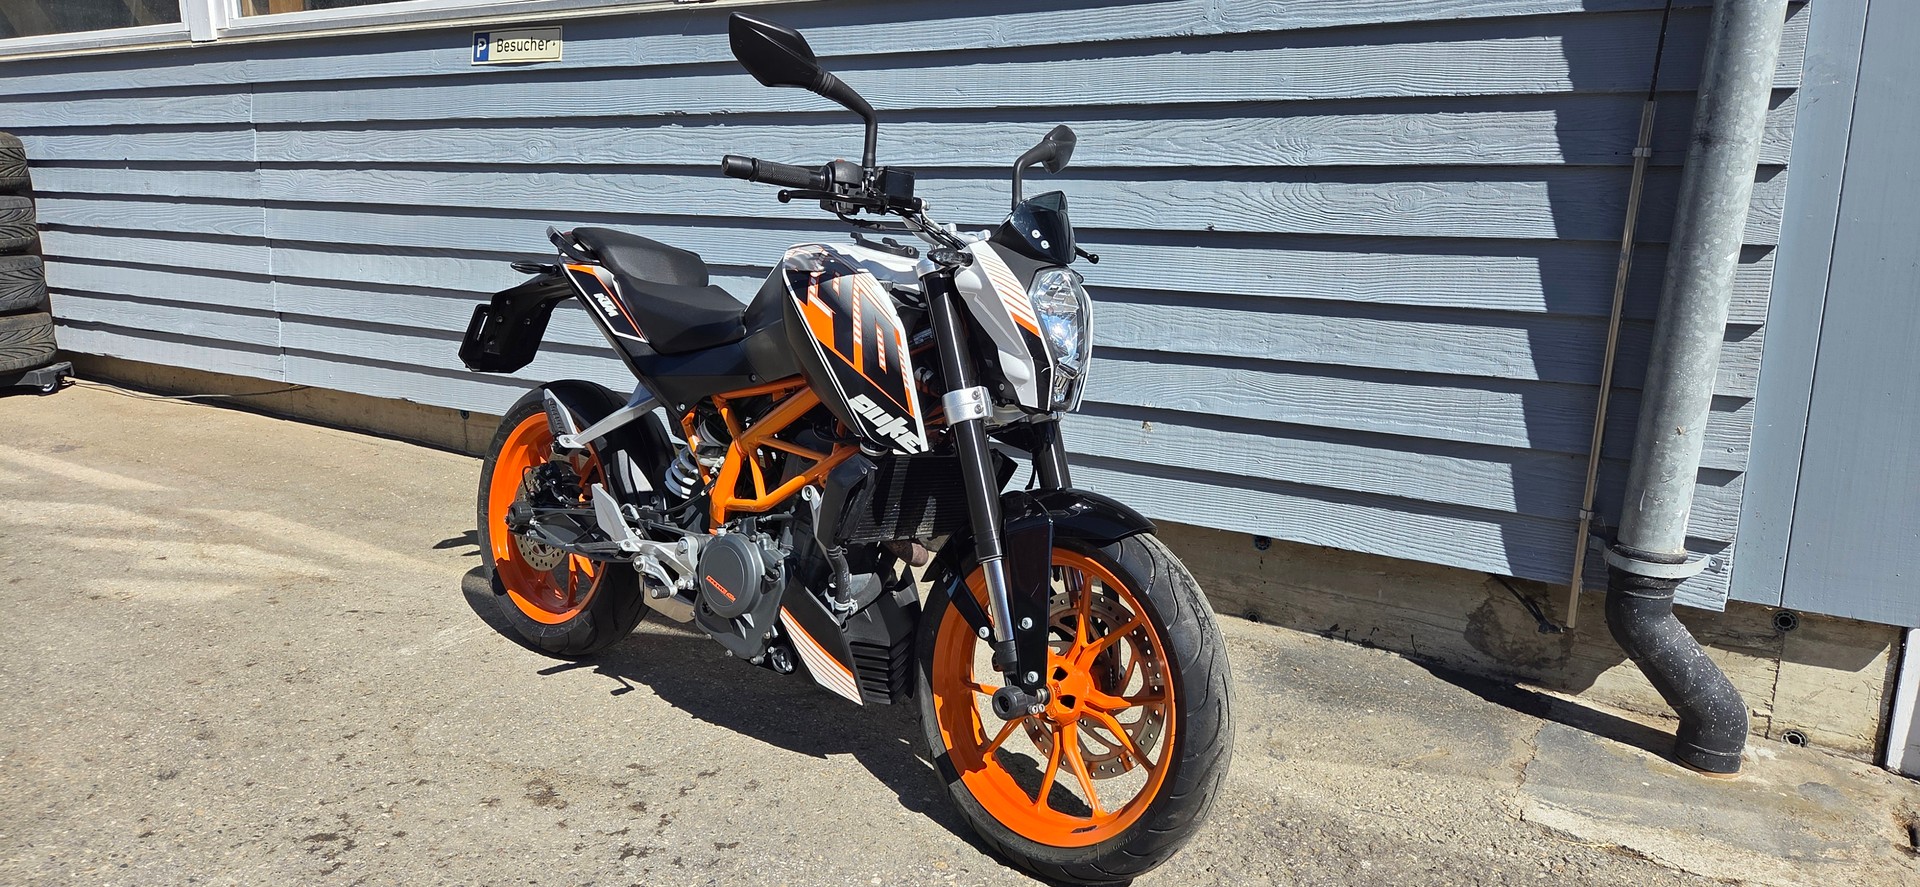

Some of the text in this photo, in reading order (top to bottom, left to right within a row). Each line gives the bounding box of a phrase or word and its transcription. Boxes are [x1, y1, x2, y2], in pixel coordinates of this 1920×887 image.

[476, 37, 550, 58] P Besucher
[593, 293, 619, 317] KTM
